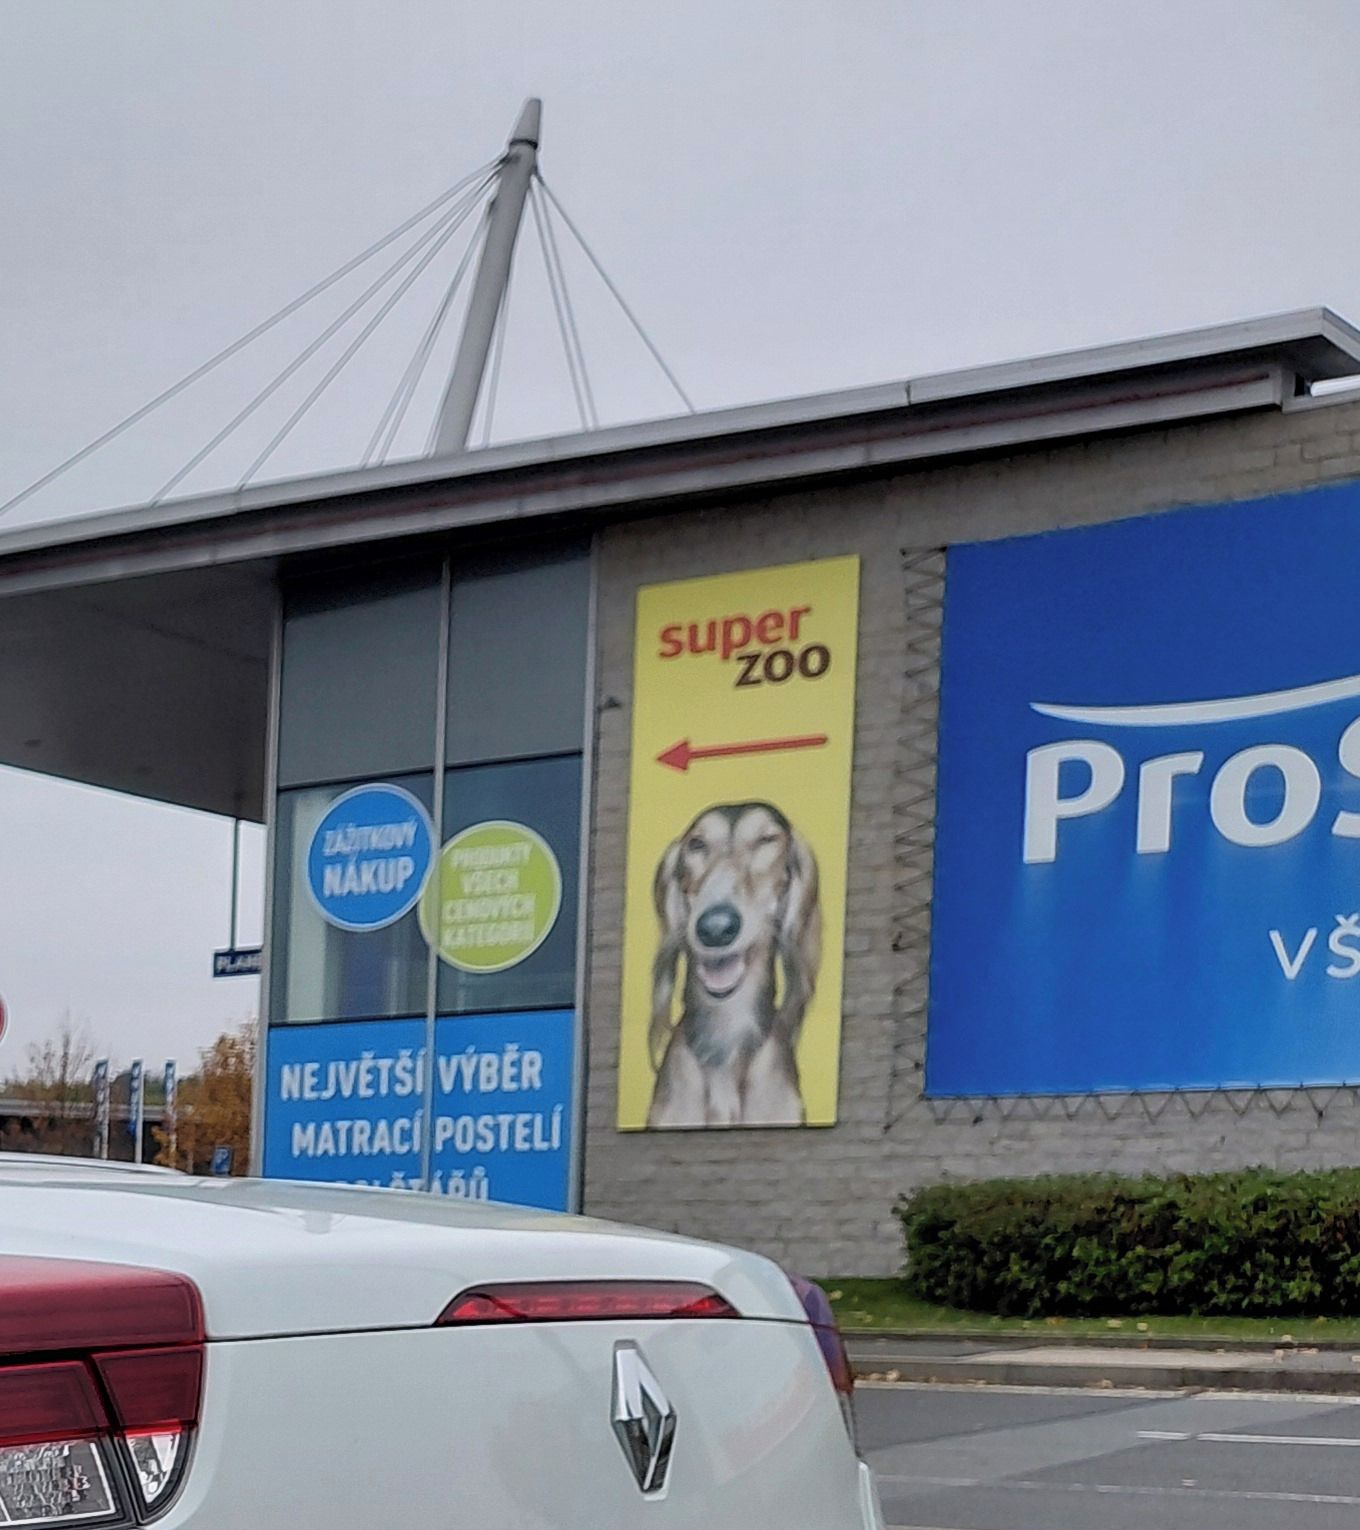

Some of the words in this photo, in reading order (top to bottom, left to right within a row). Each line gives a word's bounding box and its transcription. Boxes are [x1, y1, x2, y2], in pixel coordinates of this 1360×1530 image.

[658, 604, 812, 661] super
[733, 642, 831, 688] zoo
[323, 854, 416, 898] NÁKUP
[281, 1045, 424, 1099] NEJVĚTŠÍ
[437, 1042, 544, 1093] VÝBĚR
[291, 1107, 423, 1158] MATRACÍ
[433, 1104, 564, 1153] POSTELÍ
